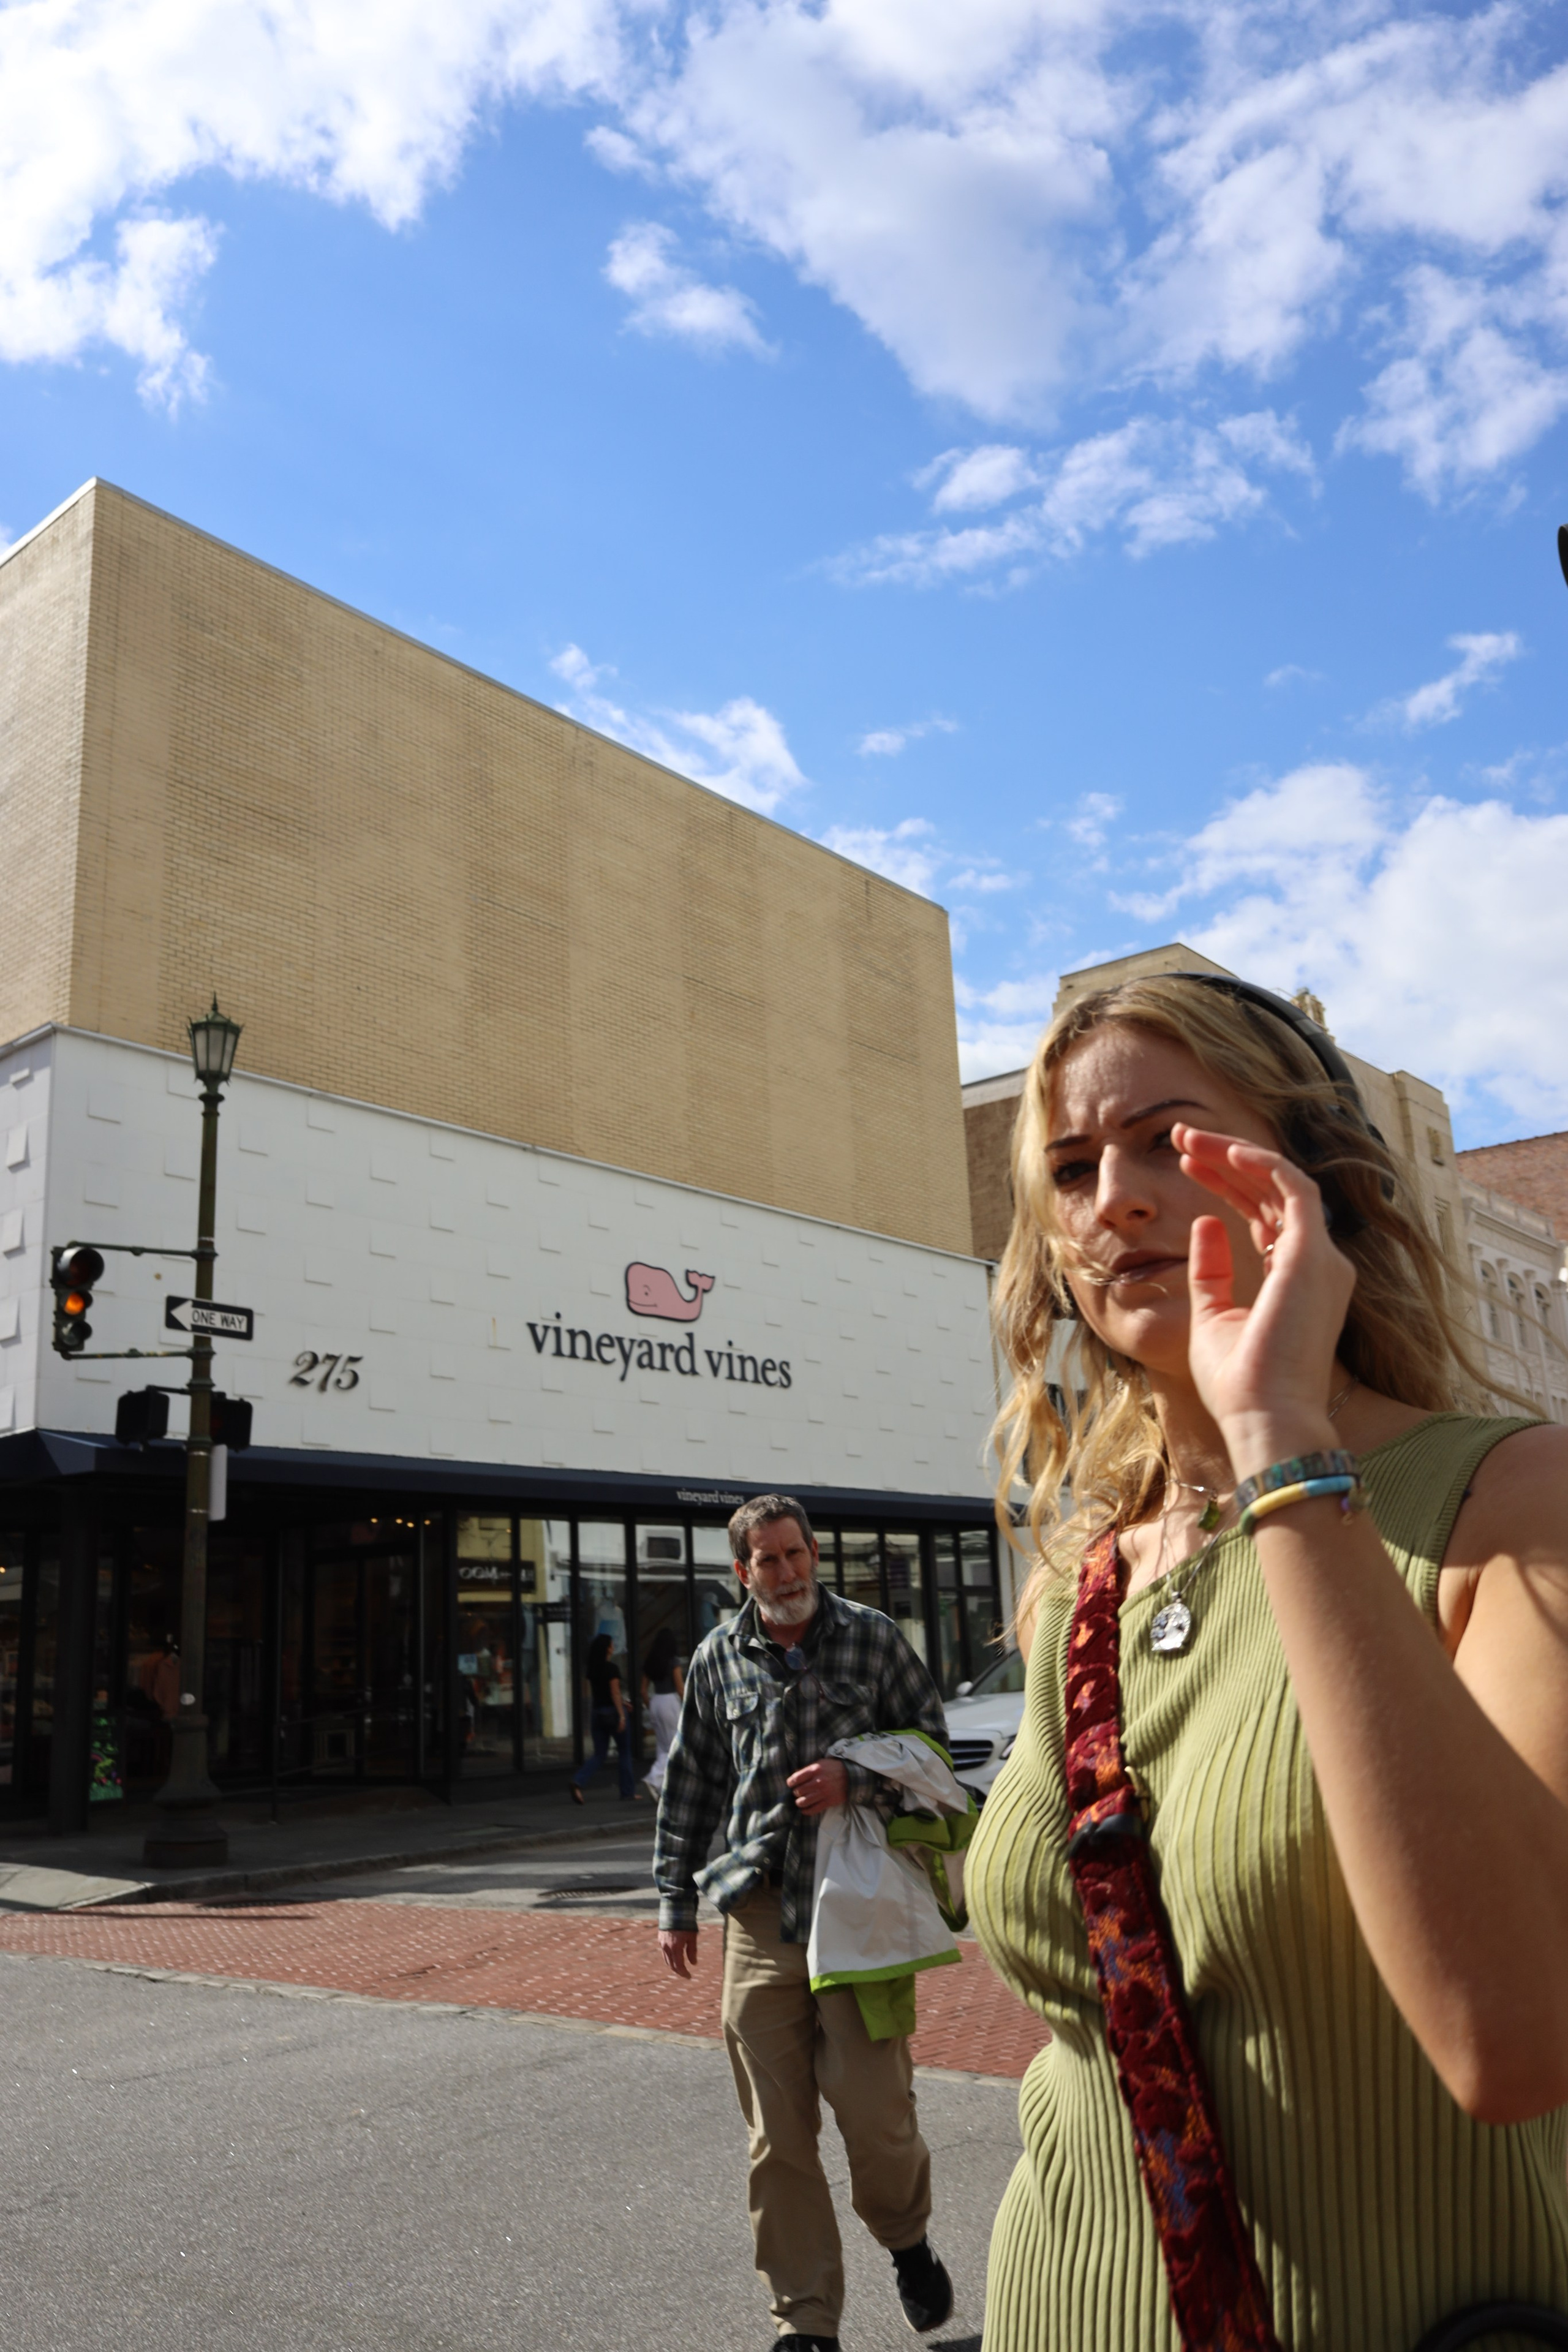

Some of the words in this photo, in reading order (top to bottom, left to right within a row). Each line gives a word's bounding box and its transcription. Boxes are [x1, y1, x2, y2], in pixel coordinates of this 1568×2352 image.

[192, 1310, 216, 1326] ONE
[221, 1314, 244, 1329] WAY
[526, 1312, 699, 1382] vineyard
[705, 1340, 792, 1389] vines
[288, 1351, 364, 1393] 275
[676, 1488, 719, 1506] vineyard
[720, 1491, 745, 1504] vines
